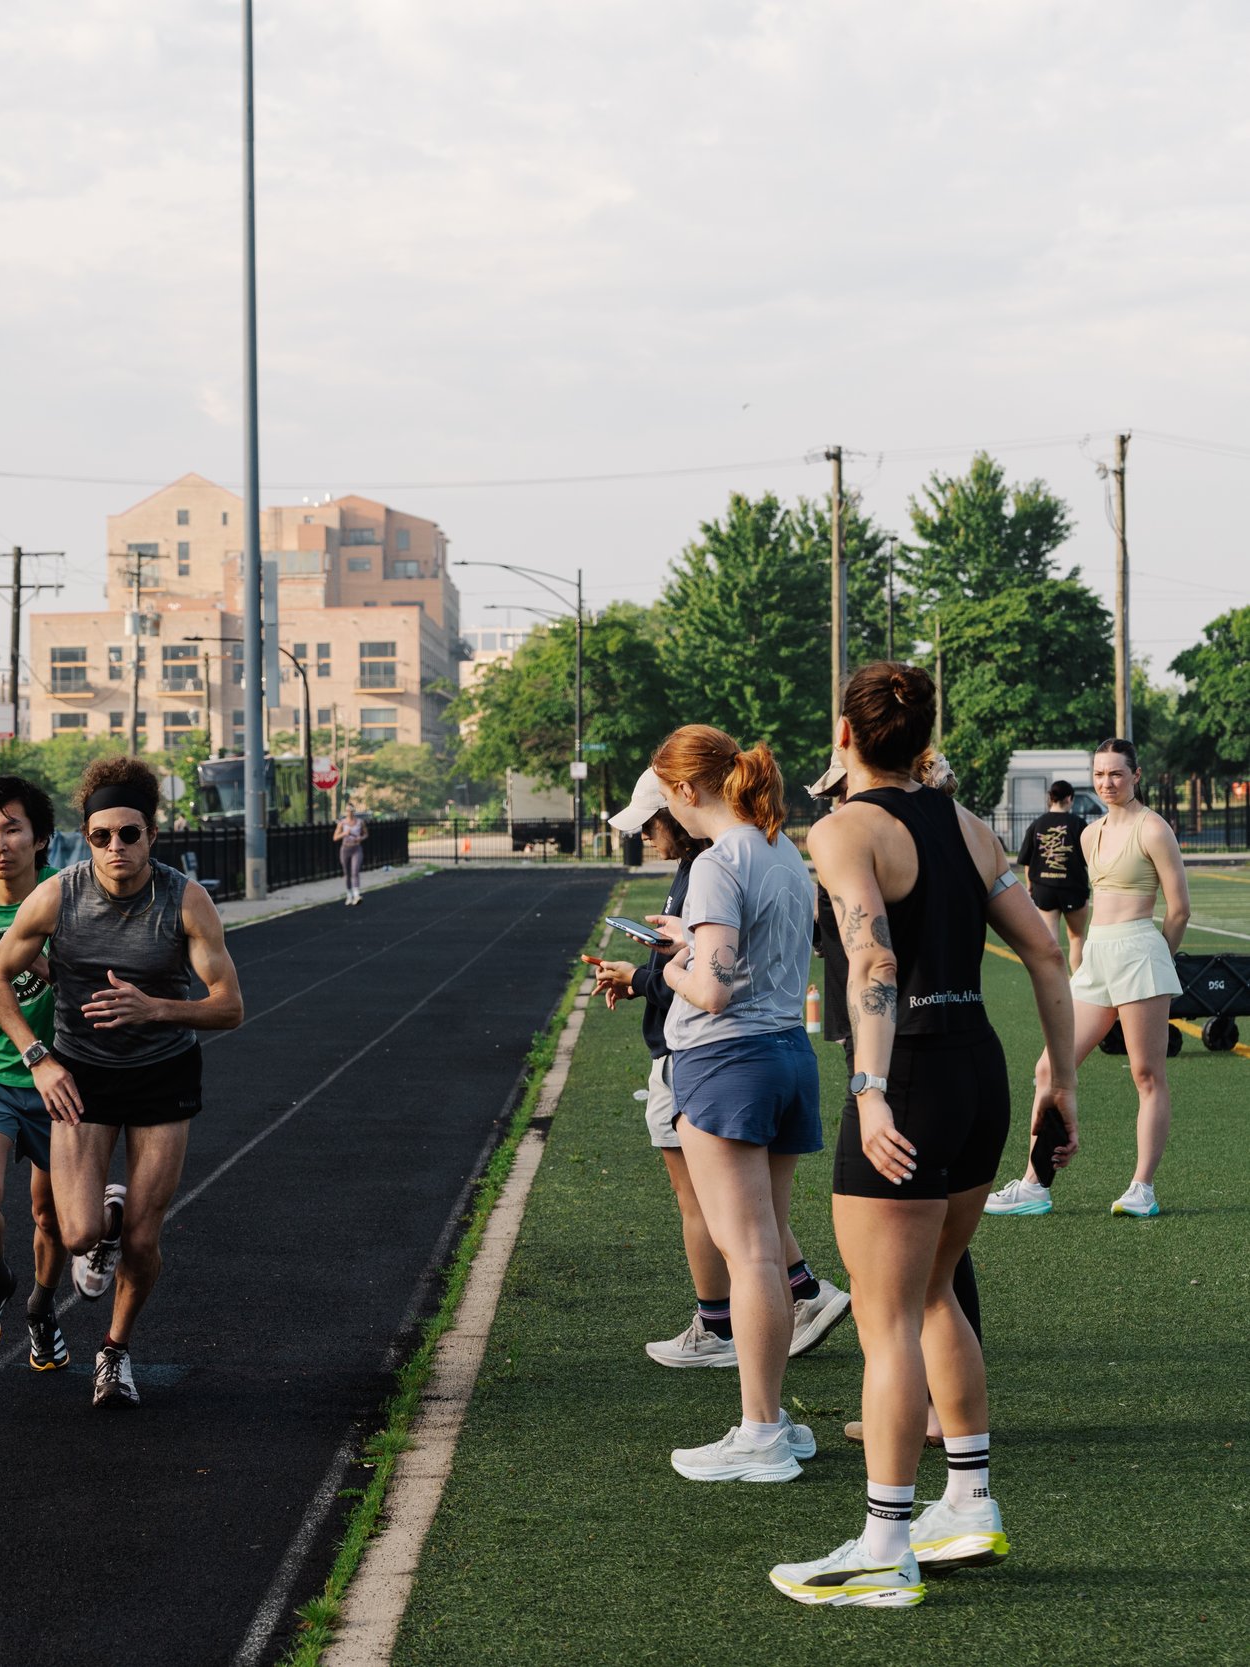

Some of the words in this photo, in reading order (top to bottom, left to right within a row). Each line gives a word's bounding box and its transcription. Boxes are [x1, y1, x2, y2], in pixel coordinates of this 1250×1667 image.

[312, 770, 337, 783] STOP
[23, 978, 43, 996] SHUFFL
[1208, 980, 1225, 990] DSG
